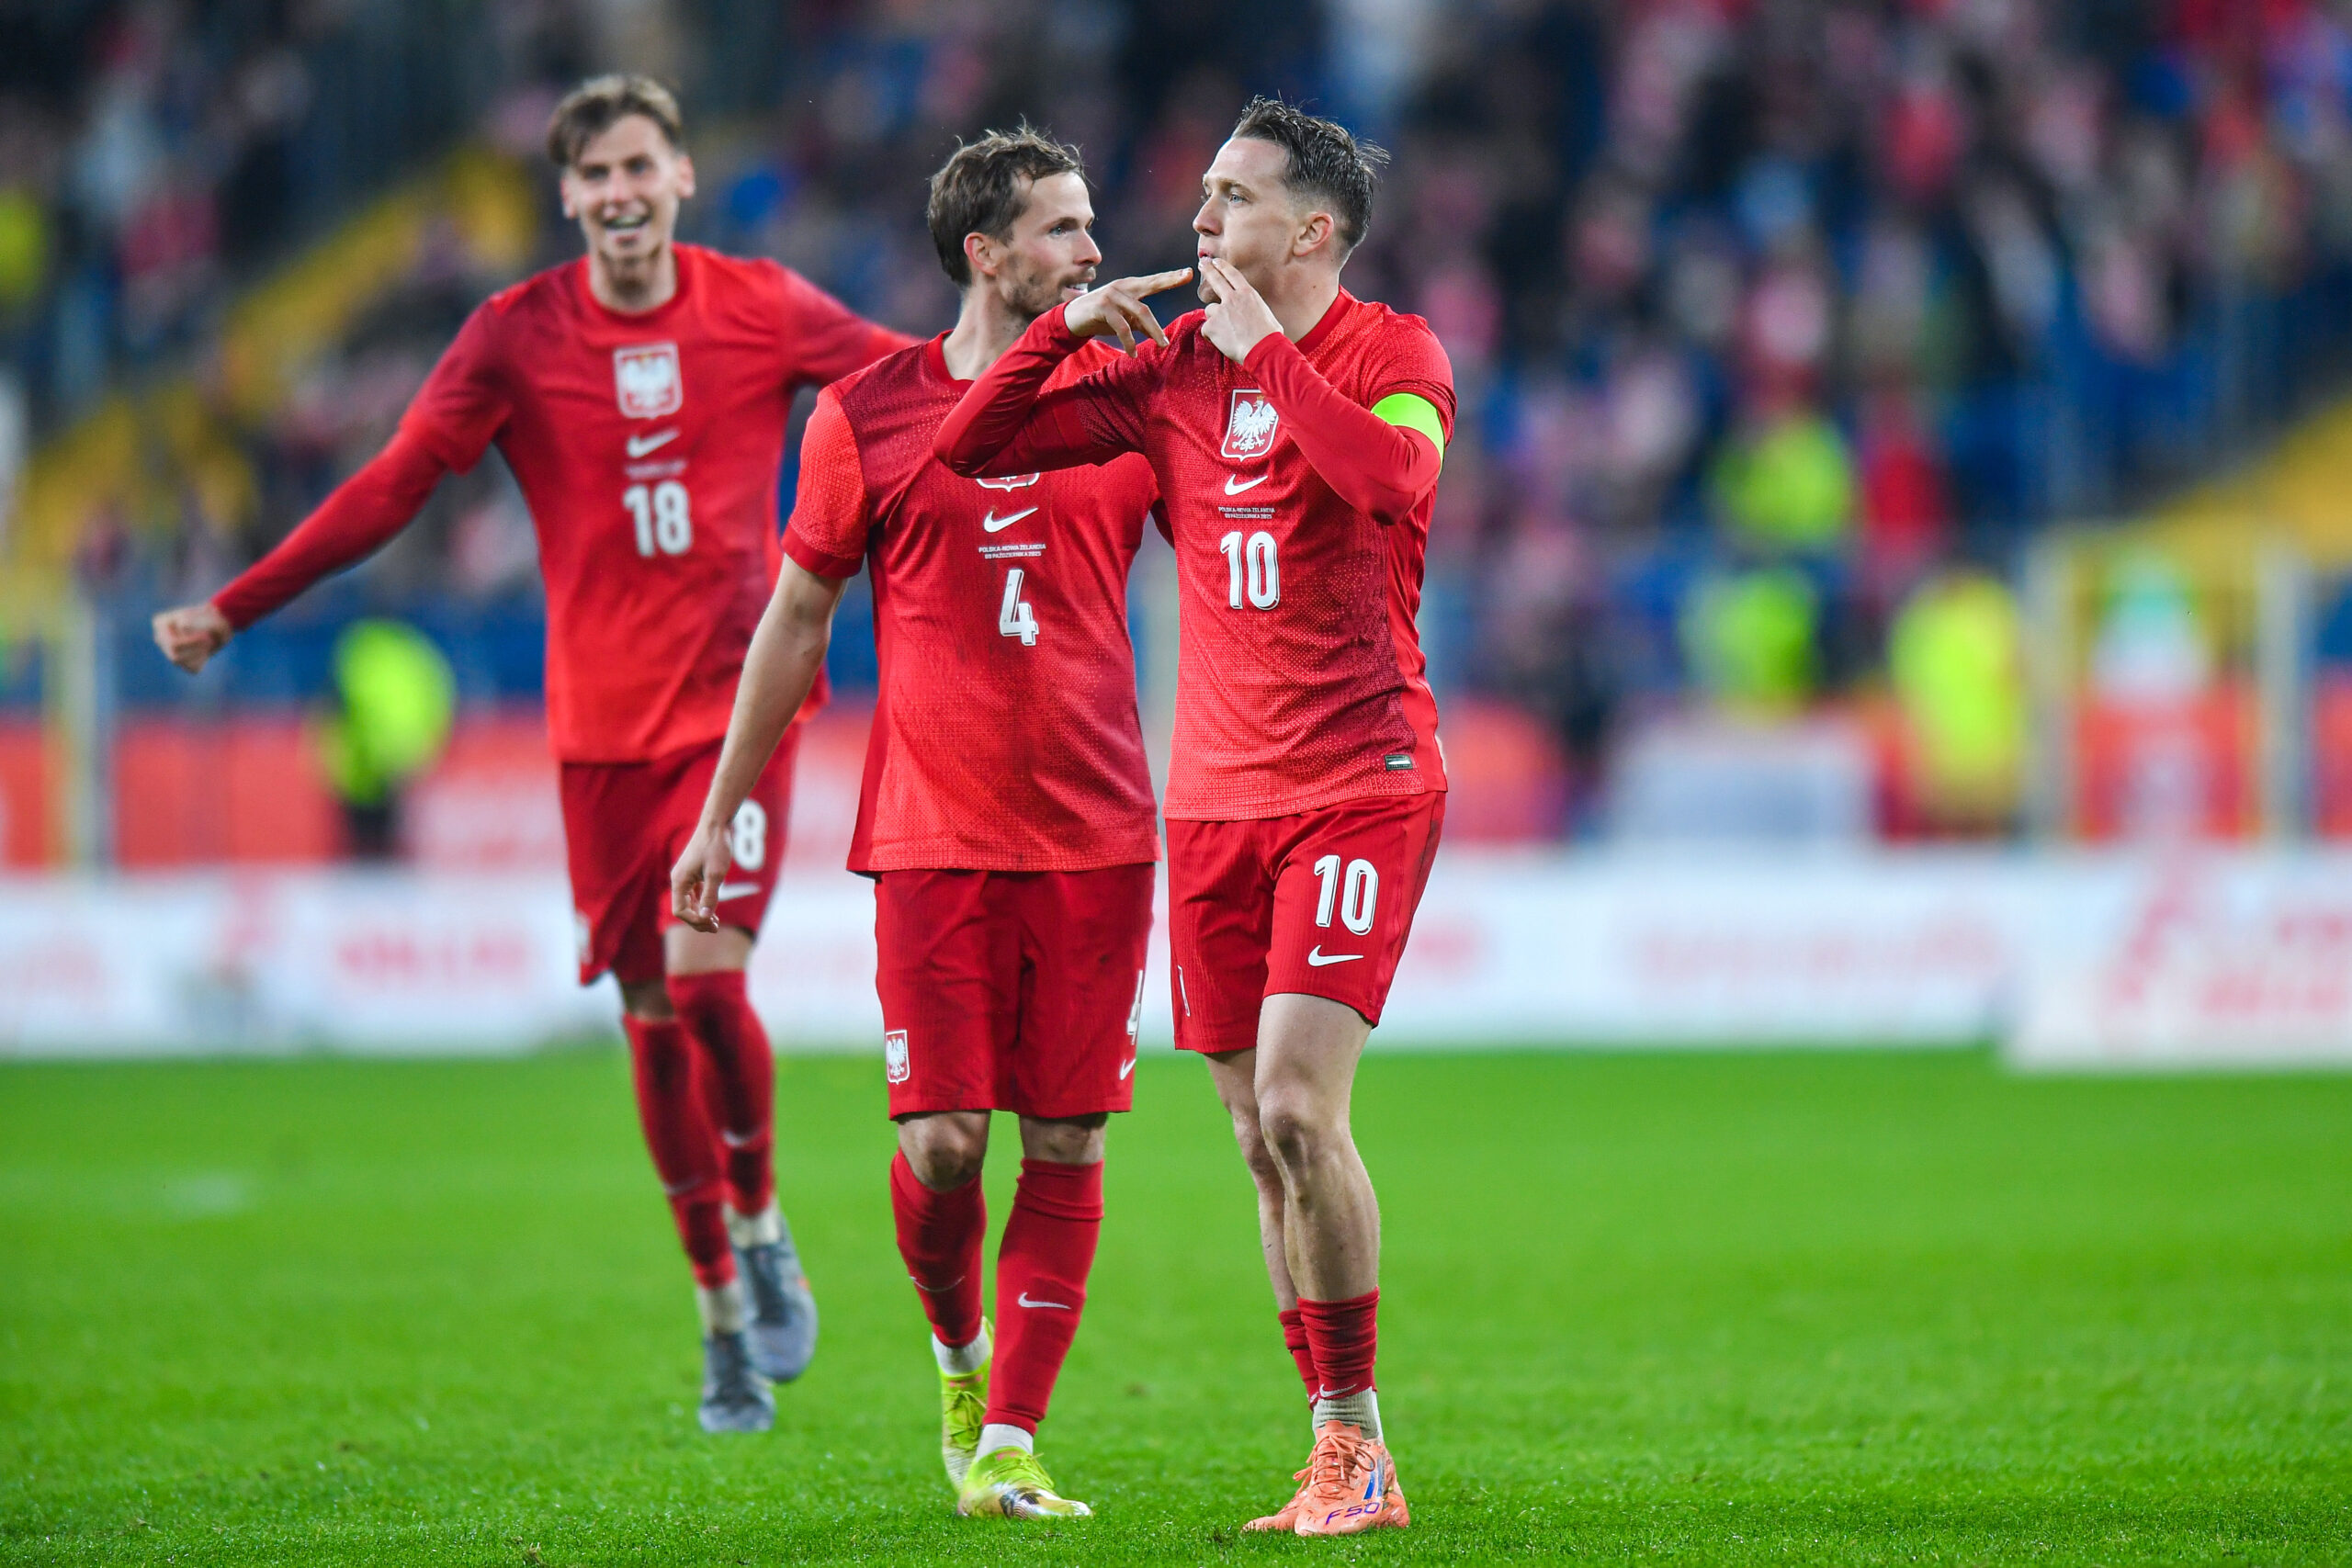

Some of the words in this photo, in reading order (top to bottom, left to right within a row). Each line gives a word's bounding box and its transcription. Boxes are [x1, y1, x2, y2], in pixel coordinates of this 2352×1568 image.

[622, 479, 693, 557] 18
[999, 567, 1039, 647] 4
[1219, 530, 1280, 611] 10
[731, 797, 767, 871] 8
[1314, 853, 1379, 936] 10
[1325, 1502, 1381, 1526] F50
